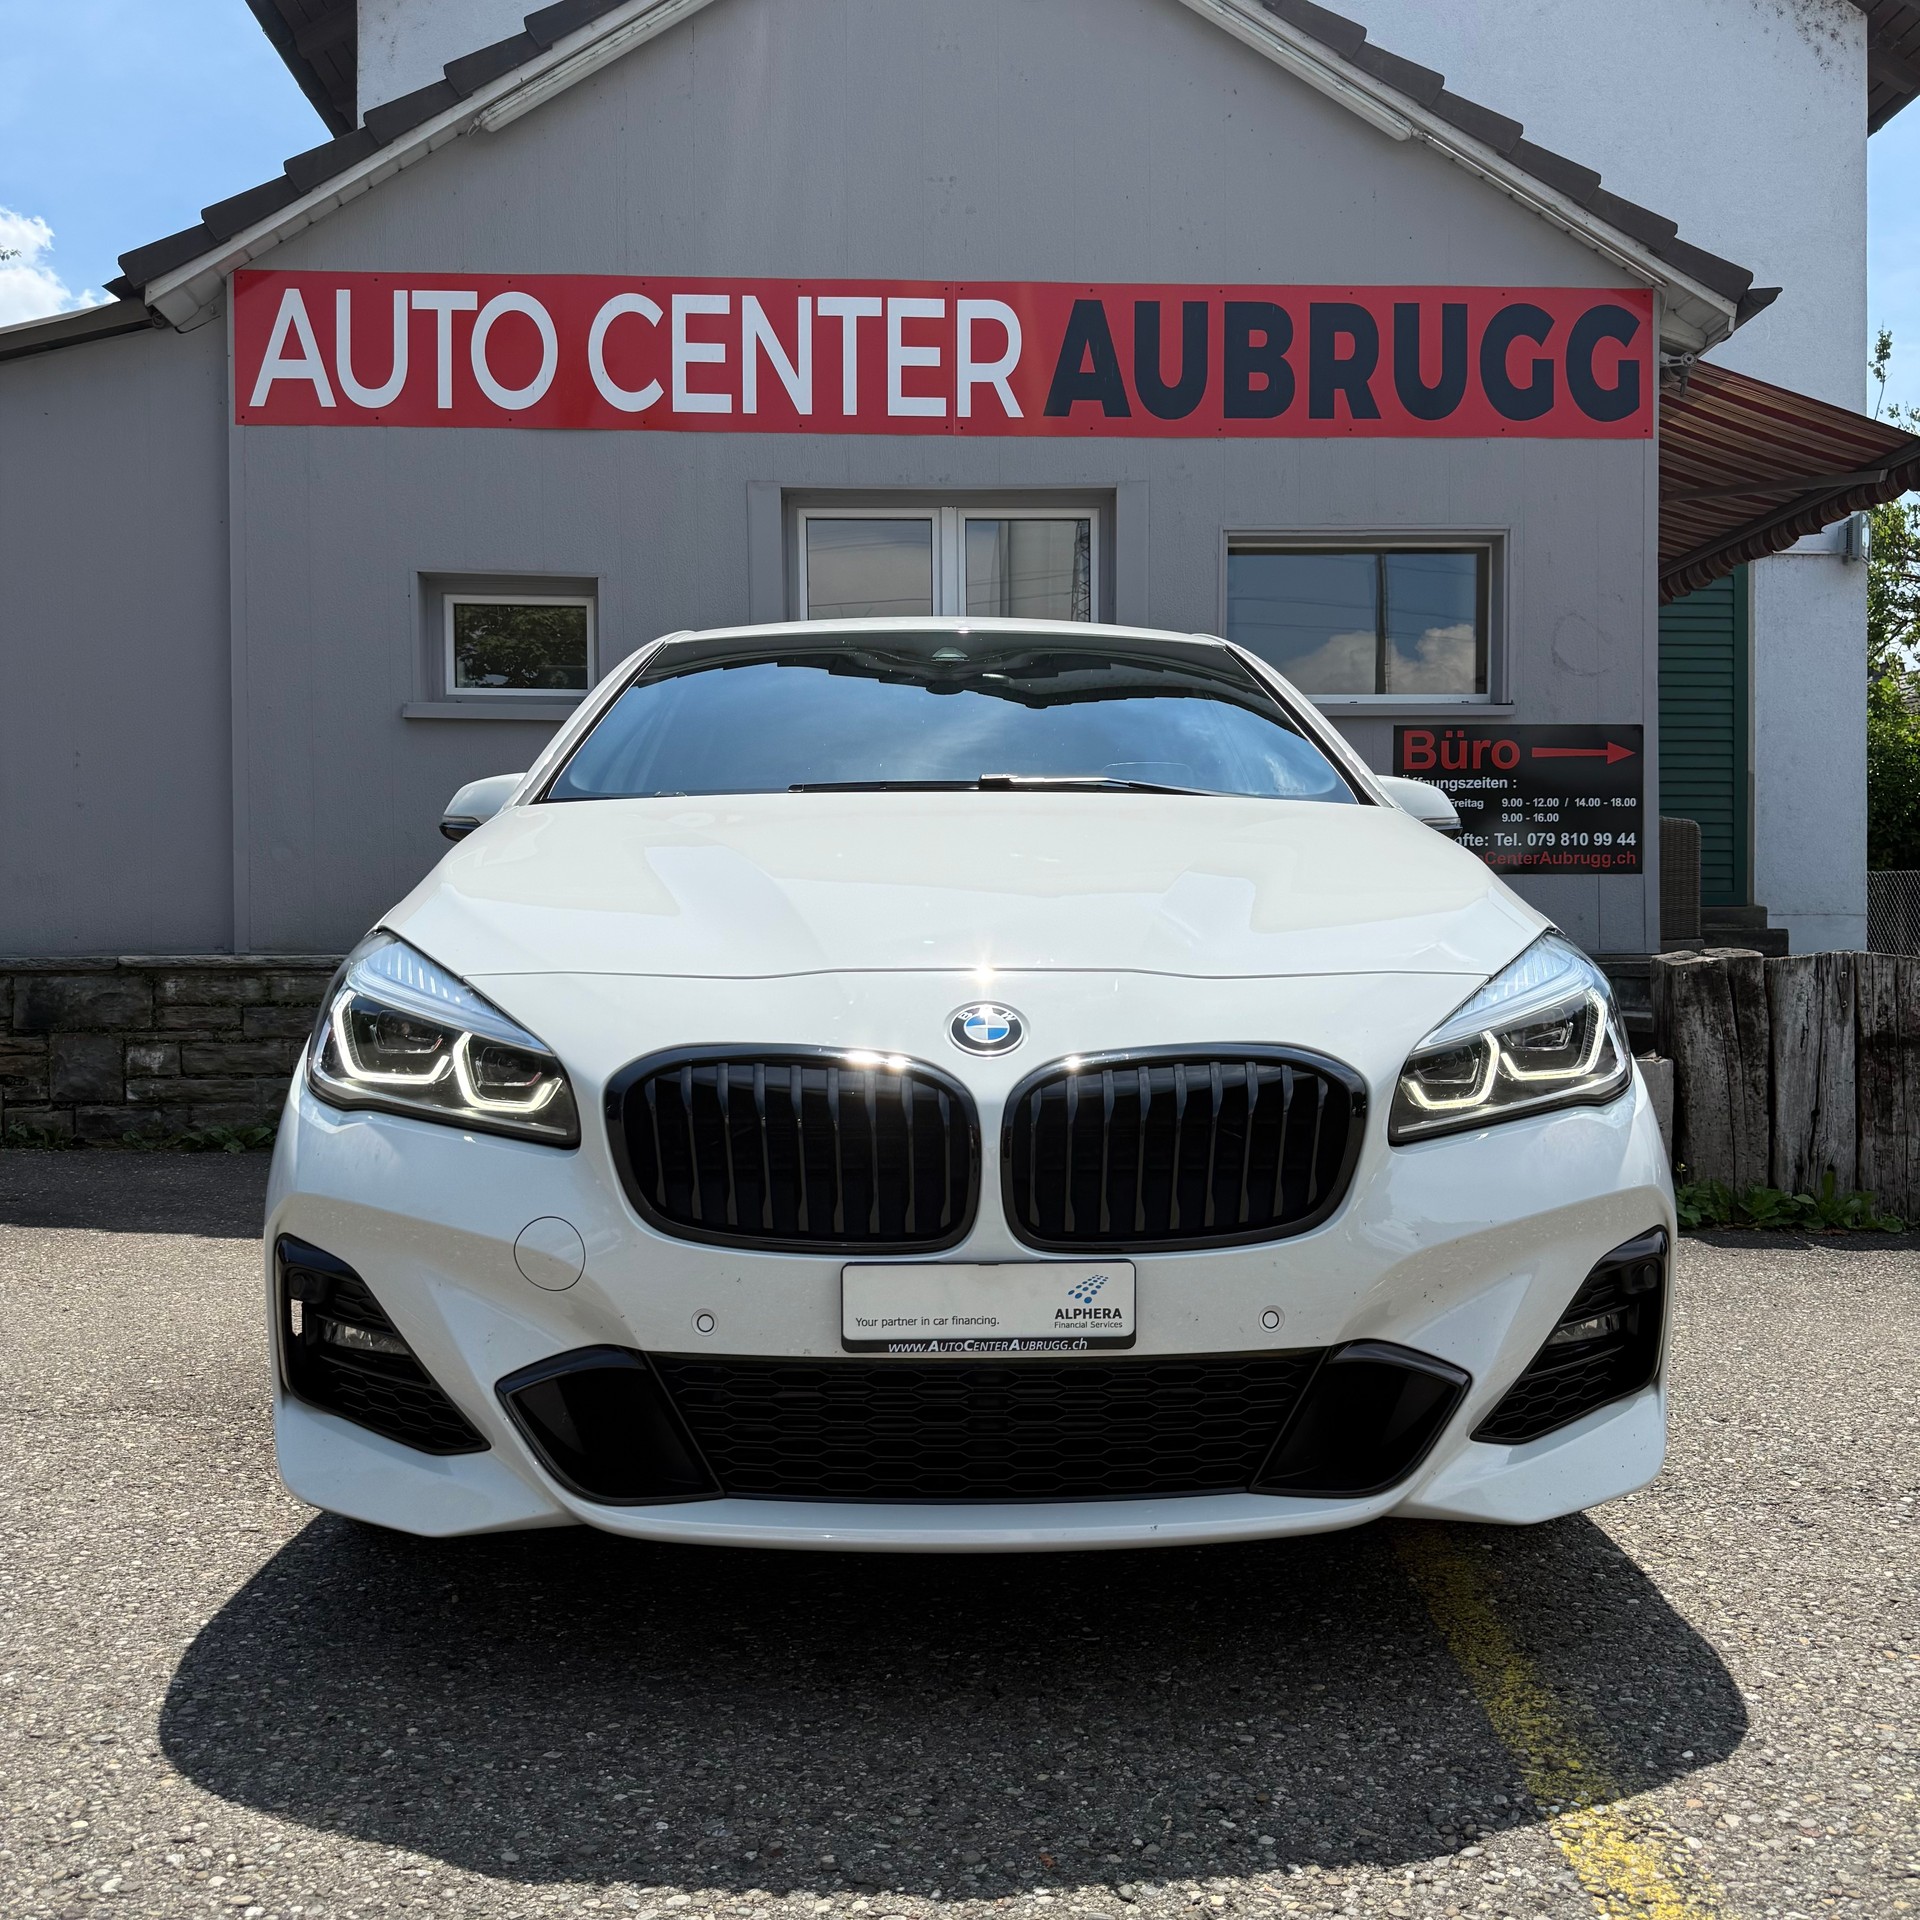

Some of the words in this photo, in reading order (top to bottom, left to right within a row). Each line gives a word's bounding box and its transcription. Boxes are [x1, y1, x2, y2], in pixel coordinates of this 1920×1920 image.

[249, 288, 558, 410] AUTO
[587, 292, 1025, 418] CENTER
[1042, 299, 1641, 423] AUBRUGG
[1403, 730, 1521, 770] Büro
[1501, 797, 1523, 808] 9.00
[1532, 797, 1560, 808] 12.00
[1574, 797, 1601, 808] 14.00
[1610, 797, 1637, 808] 18.00
[1501, 812, 1523, 823] 9.00
[1532, 812, 1560, 823] 16.00
[1493, 832, 1522, 847] Tel.
[1527, 832, 1556, 847] 079
[1560, 832, 1589, 847] 810
[1593, 832, 1612, 847] 99
[1616, 832, 1637, 847] 44
[1479, 851, 1636, 868] CenterAubrugg.ch
[1054, 1307, 1123, 1320] ALPHERA
[855, 1317, 878, 1327] Your
[881, 1317, 918, 1328] partner
[920, 1316, 930, 1326] in
[933, 1317, 949, 1326] car
[951, 1315, 1000, 1328] financing.
[1054, 1320, 1088, 1329] Financial
[1090, 1320, 1123, 1329] Services
